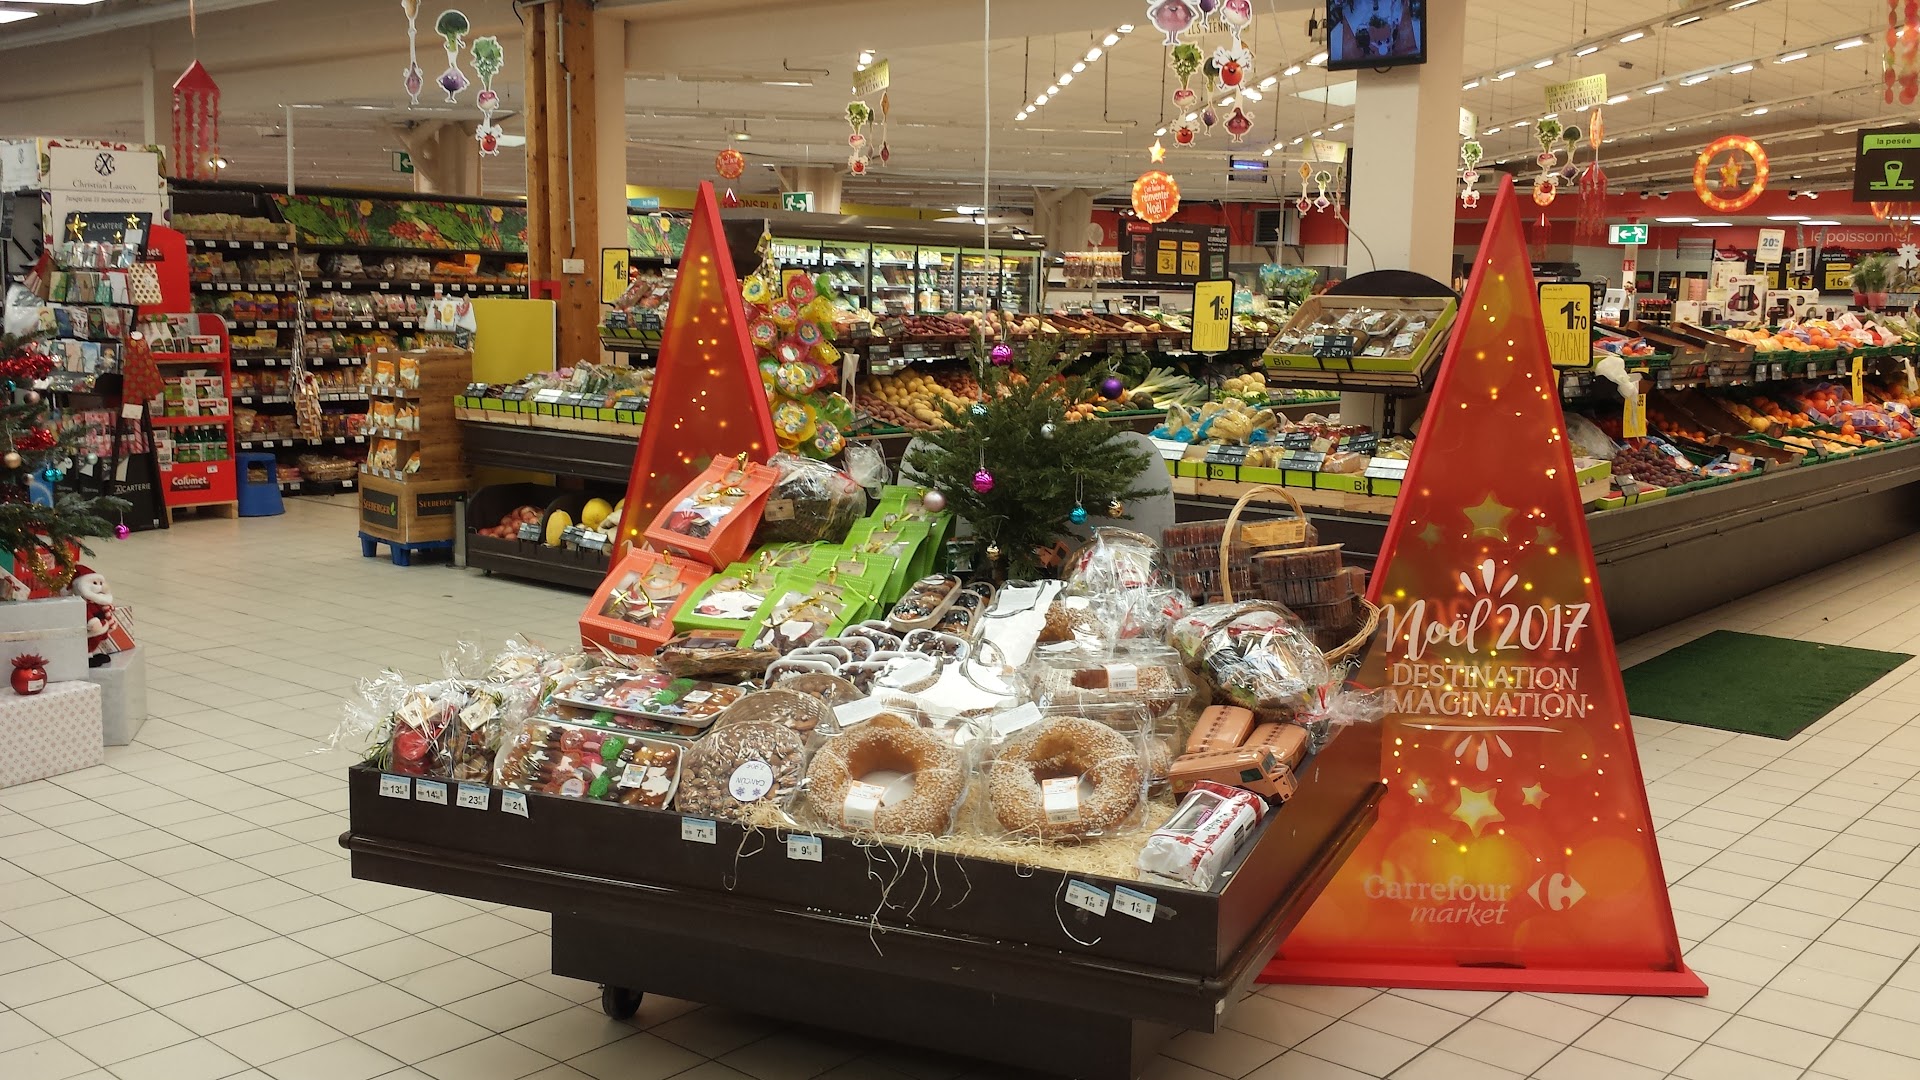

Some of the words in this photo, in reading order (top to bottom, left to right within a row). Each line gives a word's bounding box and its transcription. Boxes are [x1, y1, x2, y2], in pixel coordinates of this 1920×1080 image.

[1549, 103, 1562, 113] ILS
[1565, 95, 1601, 110] VIENNENT
[1885, 137, 1912, 146] pesée
[72, 179, 107, 190] Christian
[109, 181, 137, 190] Lacroix
[1146, 199, 1163, 215] Noël
[97, 221, 124, 230] CARTERIE
[1811, 230, 1823, 242] le
[1547, 332, 1588, 362] SPAGNE
[1273, 357, 1292, 366] Bio
[362, 498, 391, 515] SEEBERGER
[1379, 597, 1494, 662] Noël
[1495, 601, 1592, 654] 2017
[1392, 663, 1580, 691] DESTINATION
[1383, 690, 1589, 719] IMAGINATION
[1363, 873, 1512, 902] Carrefour
[1409, 901, 1509, 928] market
